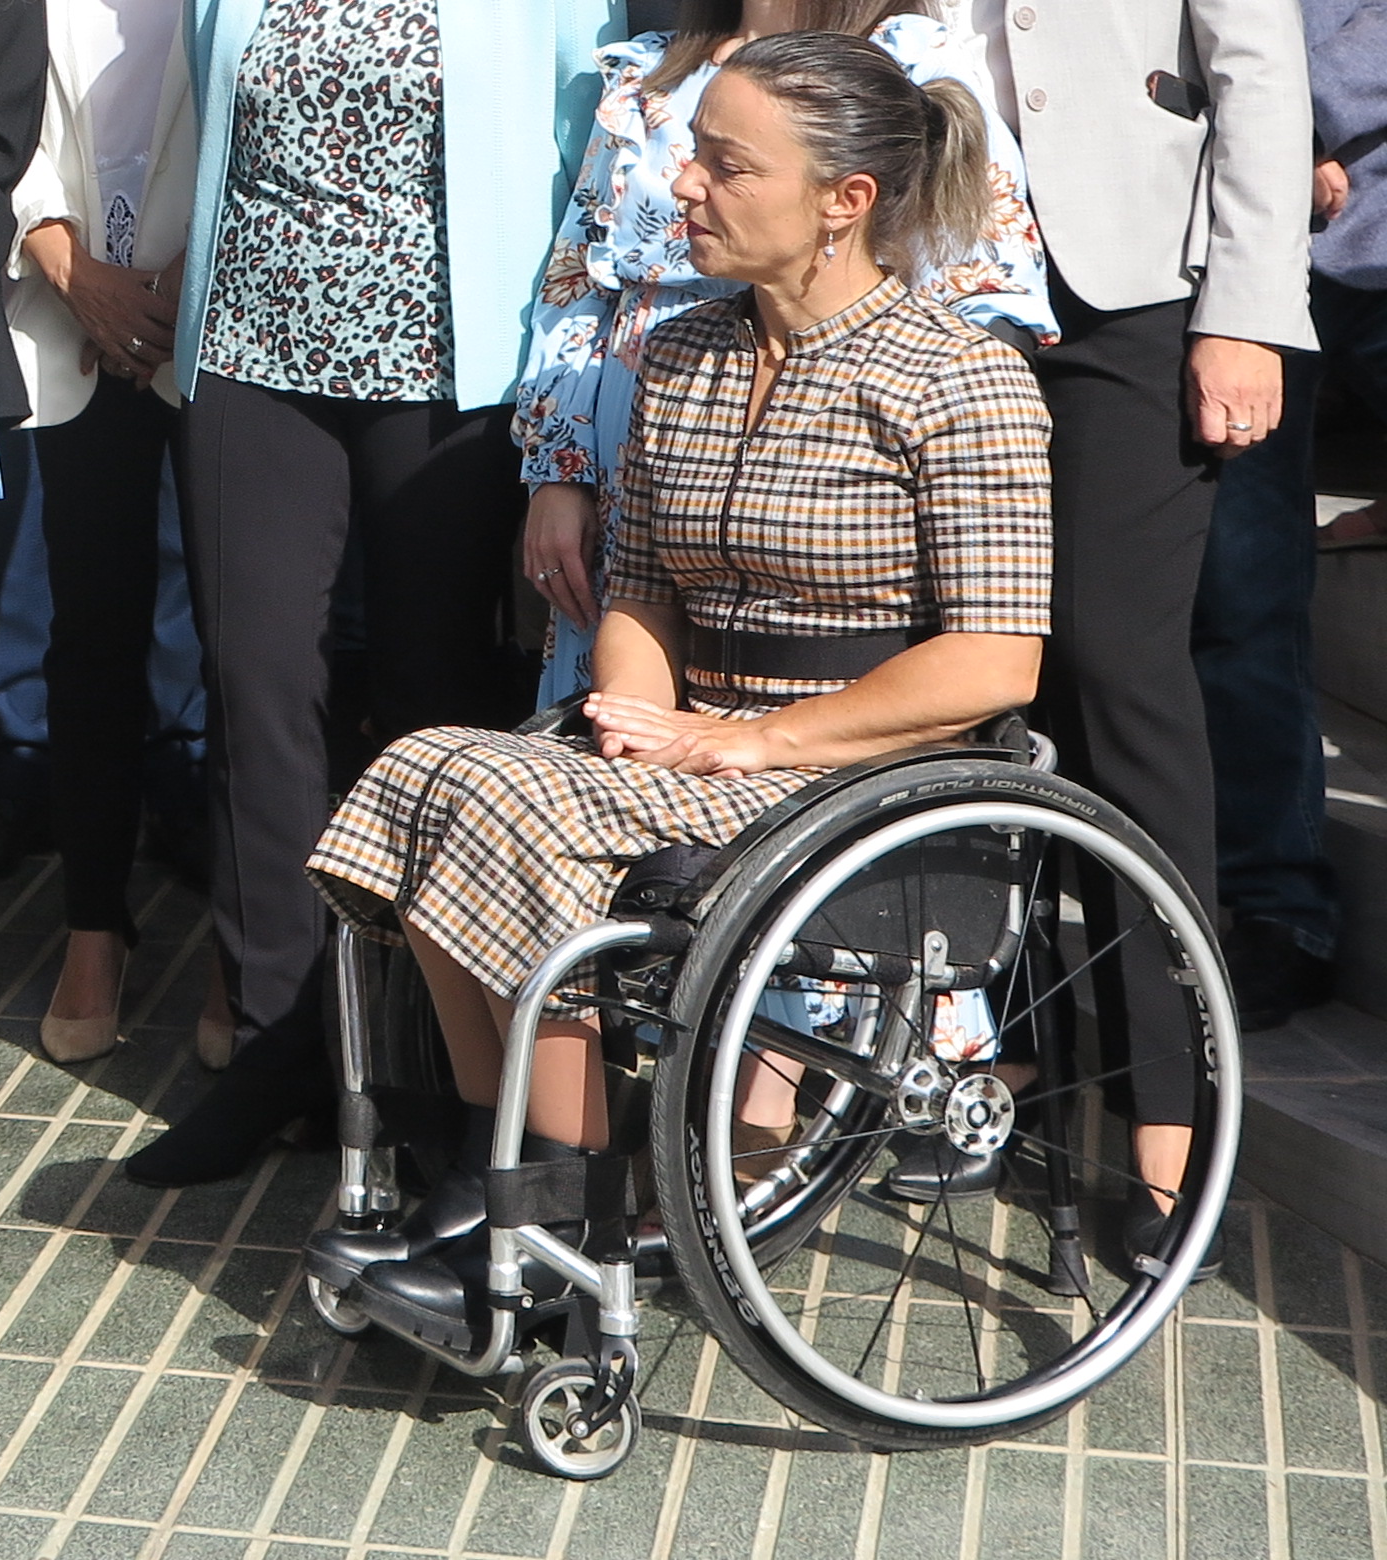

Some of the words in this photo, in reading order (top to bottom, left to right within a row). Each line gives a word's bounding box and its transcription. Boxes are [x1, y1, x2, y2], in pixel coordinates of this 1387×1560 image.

[916, 779, 975, 794] PLUS
[982, 779, 1098, 818] MARATHON
[687, 1124, 761, 1327] SPINERGY
